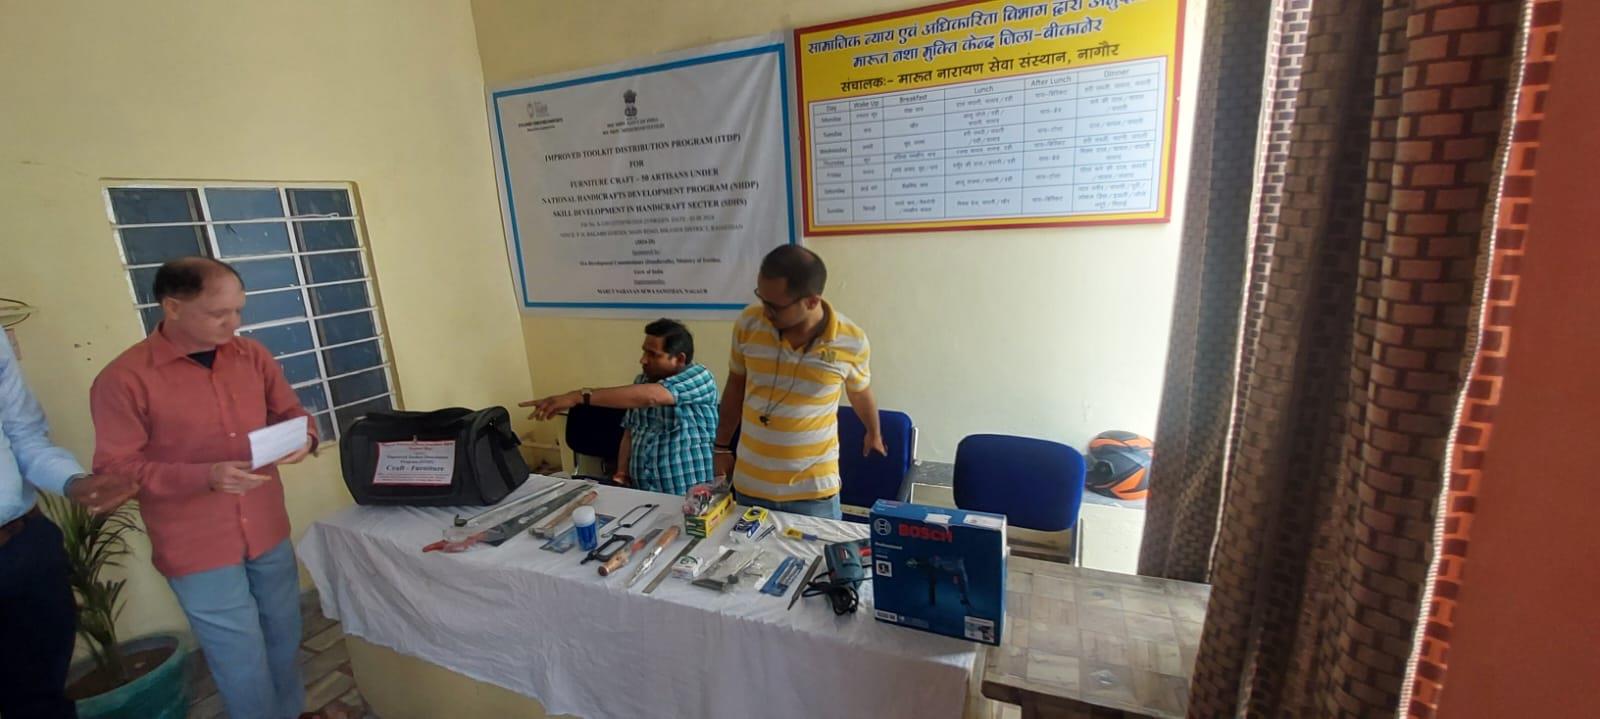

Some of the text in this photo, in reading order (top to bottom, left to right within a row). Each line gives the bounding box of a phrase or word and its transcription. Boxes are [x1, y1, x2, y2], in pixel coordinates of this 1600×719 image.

[808, 35, 860, 53] सामाजिक
[864, 30, 894, 45] न्याय
[899, 26, 917, 45] एवं
[921, 11, 998, 35] अधिकारिता
[1004, 3, 1047, 21] विभाग
[853, 52, 888, 68] मारूत
[893, 48, 918, 62] नशा
[923, 40, 957, 62] मुक्ति
[962, 35, 995, 52] केन्द्र
[898, 70, 932, 84] मारूत
[937, 63, 984, 79] नारायण
[989, 57, 1013, 72] सेवा
[1019, 52, 1071, 69] संस्थान,
[1077, 41, 1120, 60] नागौर
[1031, 75, 1071, 87] After Lunch
[1103, 68, 1130, 78] Dinner
[899, 94, 928, 103] Breakfast
[974, 86, 994, 94] Lunch
[545, 134, 741, 162] IMPROVED TOOLKIT DISTRIBUTION PROGRAM (ITDP)
[629, 160, 644, 169] FOR
[570, 179, 608, 189] FURNITURE
[610, 176, 634, 185] CRAFT
[650, 171, 688, 181] ARTISANS
[690, 168, 719, 177] UNDER
[542, 180, 759, 205] NATIONAL HANDICRAFTS DEVELOPMENT PROGRAM (NHDP)
[574, 206, 624, 217] DEVELOPMENT
[627, 205, 635, 213] IN
[636, 201, 685, 213] HANDICRAFT
[687, 199, 719, 209] SECTER
[411, 464, 444, 472] Furniture
[898, 524, 953, 543] BOSCH
